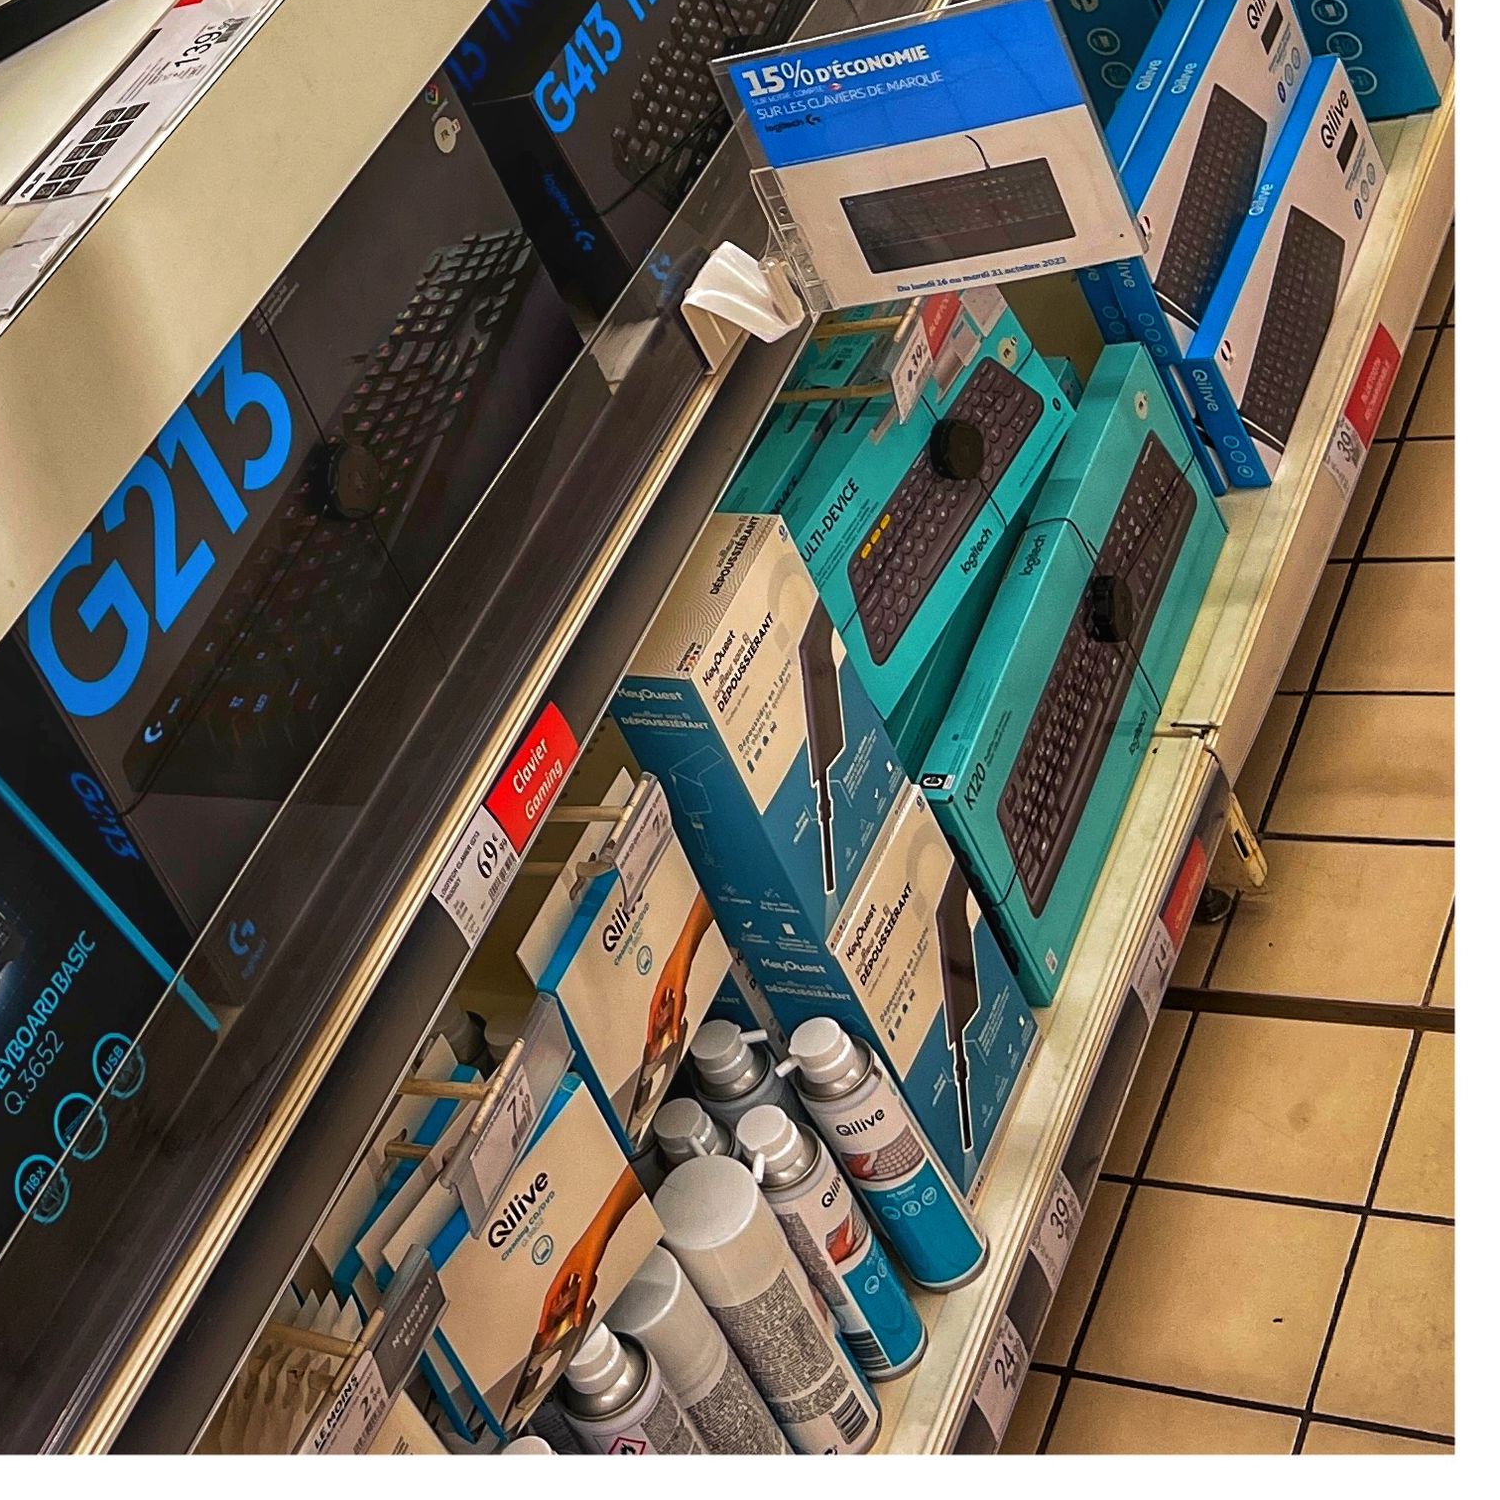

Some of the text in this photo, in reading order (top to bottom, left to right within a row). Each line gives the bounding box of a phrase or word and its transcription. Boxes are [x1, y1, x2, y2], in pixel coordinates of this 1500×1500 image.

[173, 28, 224, 70] 139
[533, 3, 625, 135] G413
[741, 45, 931, 98] 15% D'ÉCONOMIE
[757, 70, 945, 121] SUR LES CLAVIERS DE MARQUE
[1134, 58, 1164, 92] Qilive
[1169, 60, 1198, 95] Qilive
[1319, 88, 1351, 150] Qilive
[1247, 182, 1274, 217] Qilive
[896, 284, 911, 293] Du
[910, 280, 936, 292] lundi
[1191, 368, 1220, 413] Qilive
[25, 328, 294, 719] G213
[801, 476, 860, 565] ULTI-DEVICE
[710, 516, 761, 595] DÉPOUSSIÉRANT
[959, 527, 993, 575] logitech
[1018, 532, 1048, 578] logitech
[702, 629, 737, 687] KeyQuest
[716, 612, 774, 714] DÉPOUSSIÉRANT
[617, 687, 685, 703] KeyQuest
[620, 715, 709, 731] DÉPOUSSIÉRANT
[512, 738, 549, 795] Clavier
[524, 757, 564, 821] Gaming
[964, 764, 988, 811] K120
[845, 903, 879, 963] KeyQuest
[859, 881, 915, 988] DÉPOUSSIÉRANT
[52, 929, 97, 999] BASIC
[760, 956, 827, 975] KeyQuest
[764, 983, 852, 1002] DÉPOUSSIÉRANT
[2, 1029, 66, 1117] Q.3652
[101, 1042, 126, 1077] USB
[835, 1107, 886, 1138] Qilive
[487, 1171, 550, 1249] Qilive
[1049, 1199, 1069, 1239] 39
[500, 1225, 531, 1262] Cleaning
[391, 1277, 434, 1348] Nettoyant
[314, 1373, 360, 1450] LE MOINS
